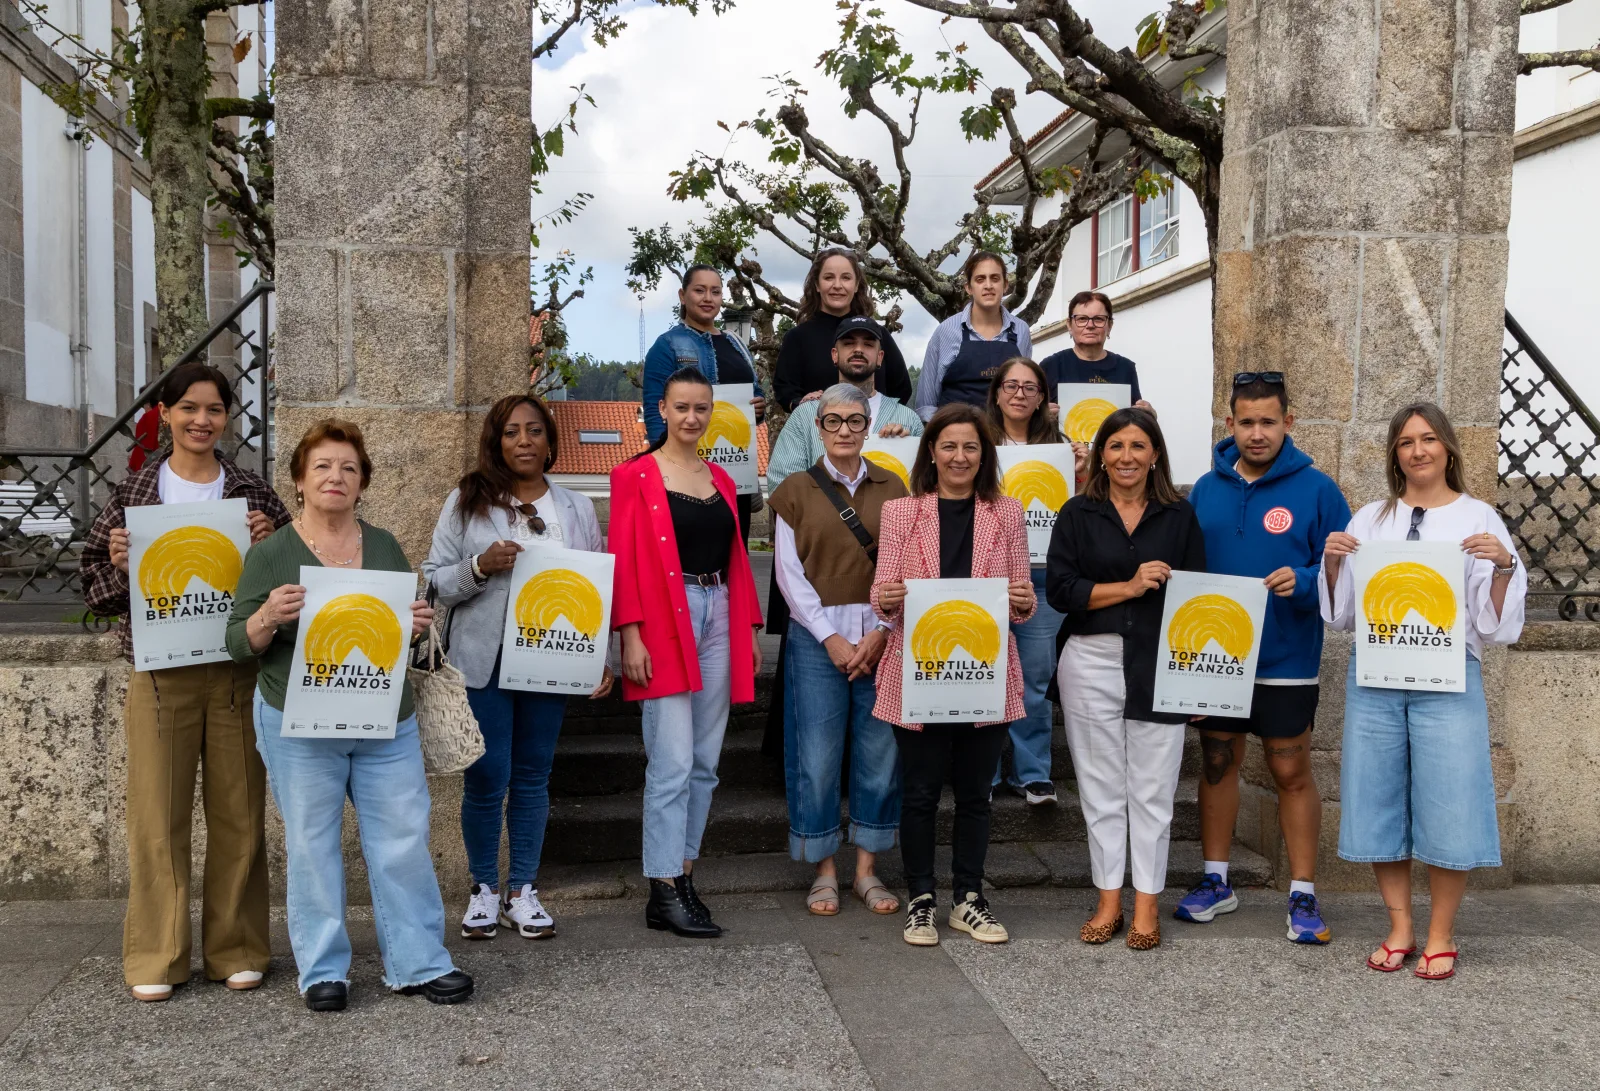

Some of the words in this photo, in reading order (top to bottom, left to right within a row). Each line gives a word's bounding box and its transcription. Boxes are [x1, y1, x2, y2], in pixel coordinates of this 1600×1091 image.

[698, 446, 744, 456] ORTILLA
[145, 590, 232, 608] TORTILLA
[518, 627, 590, 642] TORTILLA
[1368, 624, 1445, 635] TORTILLA
[516, 638, 594, 653] BETANZOS
[1368, 634, 1452, 646] BETANZOS
[1170, 651, 1239, 665] TORTILLA
[306, 663, 385, 677] TORTILLA
[916, 661, 989, 670] TORTILLA
[1169, 661, 1244, 675] BETANZOS
[915, 671, 994, 680] BETANZOS
[303, 676, 391, 689] BETANZOS
